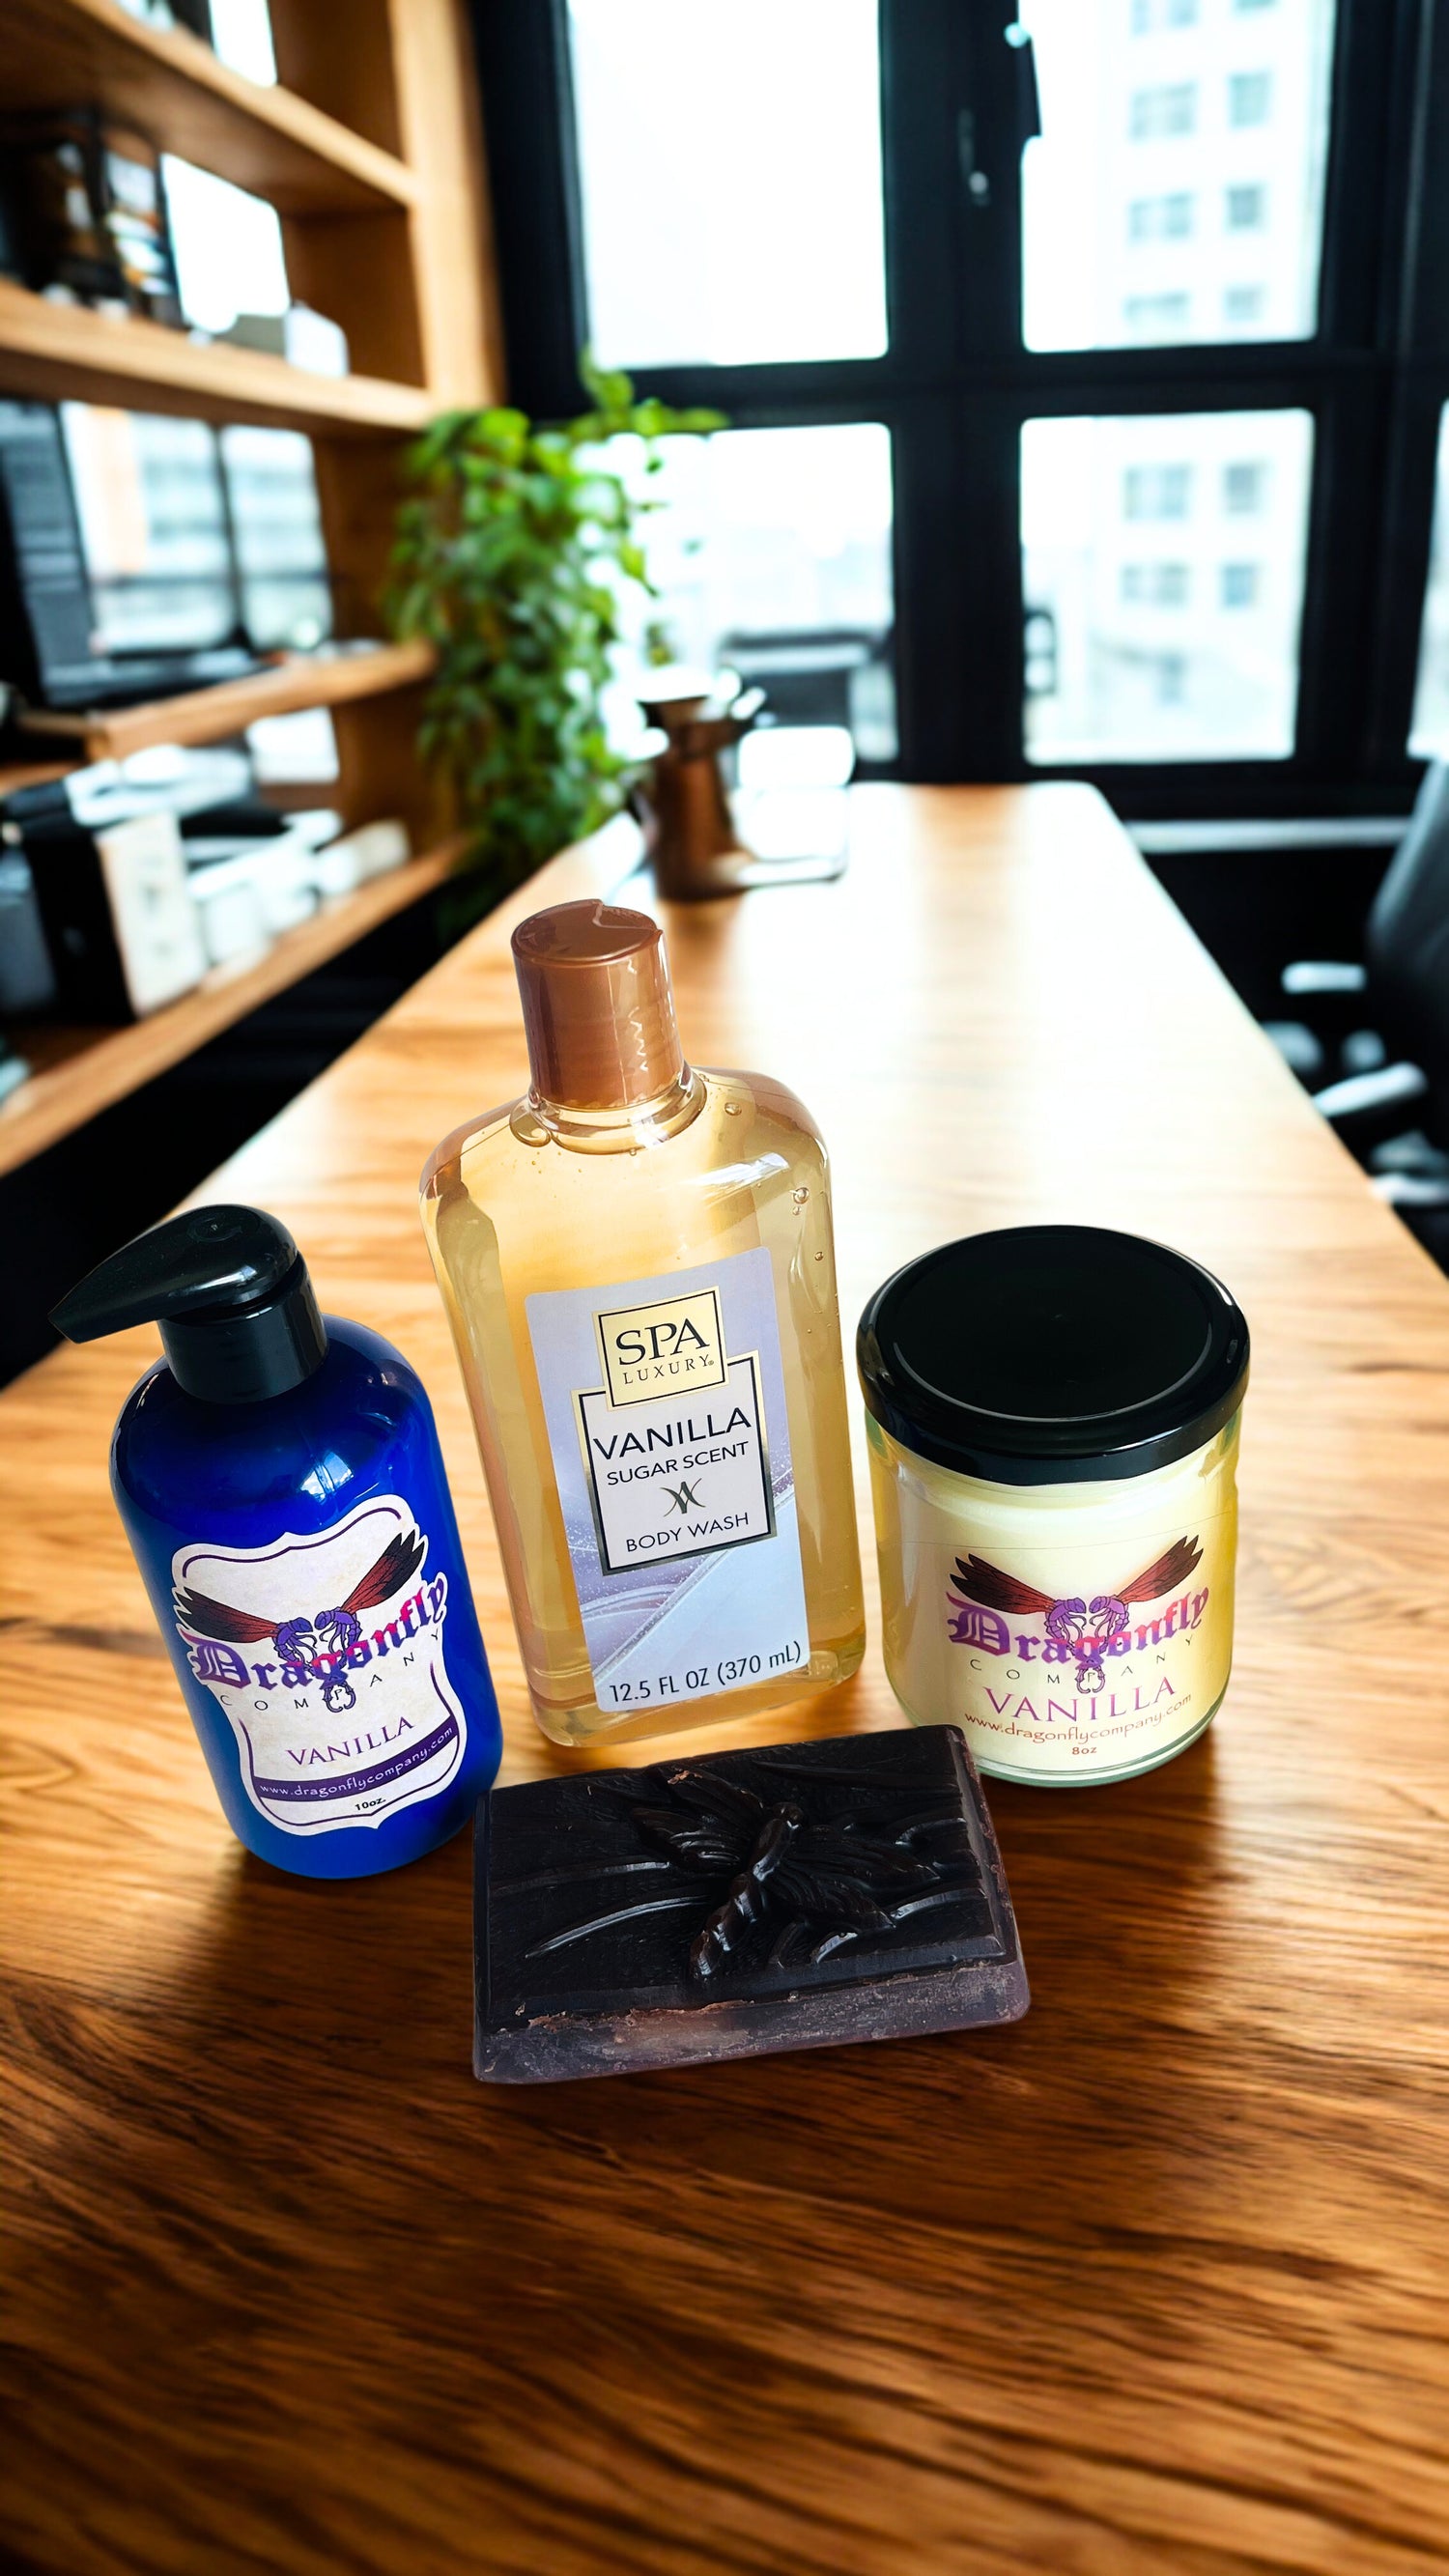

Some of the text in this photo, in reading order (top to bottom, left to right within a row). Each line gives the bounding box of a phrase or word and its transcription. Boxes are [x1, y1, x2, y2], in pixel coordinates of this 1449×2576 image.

[615, 1317, 710, 1366] SPA
[593, 1407, 752, 1460] VANILLA
[607, 1441, 749, 1486] SUGAR SCENT
[626, 1512, 750, 1552] BODY WASH
[179, 1578, 445, 1691] Dragonfly
[945, 1586, 1209, 1671] Dragonfly
[219, 1628, 440, 1712] COMPANY
[610, 1641, 802, 1702] 12.5 FL OZ (370 mL)
[970, 1634, 1194, 1685] COMPANY
[964, 1693, 1192, 1744] www.dragonflycompany.com
[982, 1676, 1176, 1722] VANILLA
[259, 1726, 453, 1798] www.dragonflycompany.com
[286, 1716, 415, 1767] VANILLA
[1071, 1745, 1097, 1756] 8oz
[355, 1797, 387, 1812] 10oz.
